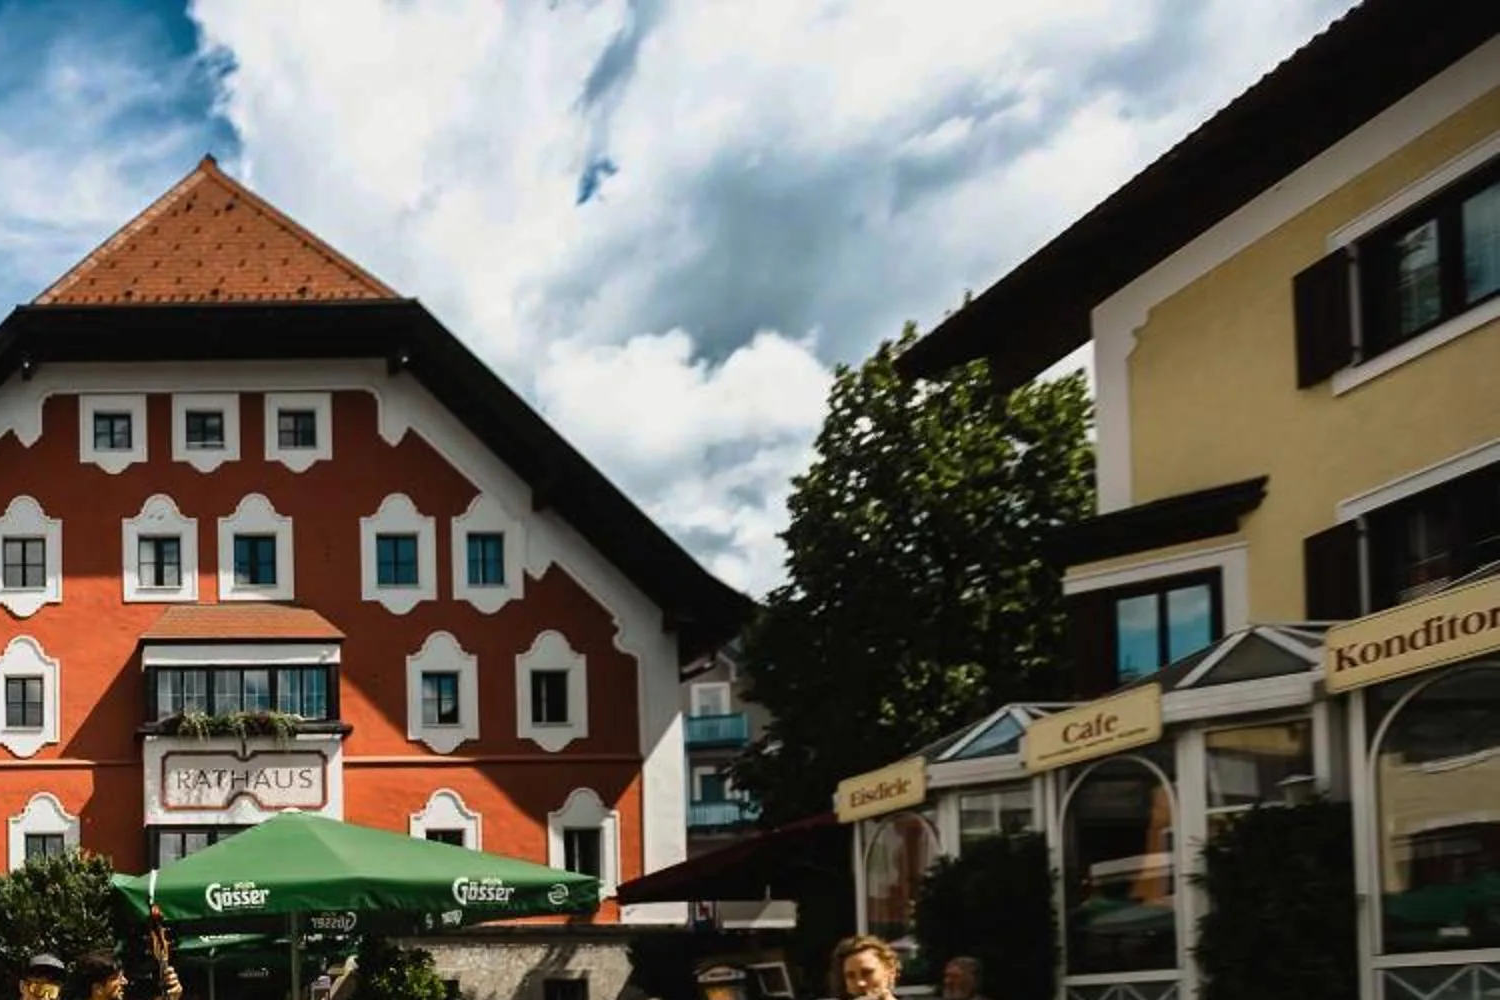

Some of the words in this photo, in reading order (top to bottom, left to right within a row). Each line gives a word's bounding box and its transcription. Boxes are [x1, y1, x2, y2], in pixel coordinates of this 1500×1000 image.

[177, 768, 312, 790] RATHAUS
[205, 882, 270, 912] Gösser
[452, 877, 515, 906] Gösser
